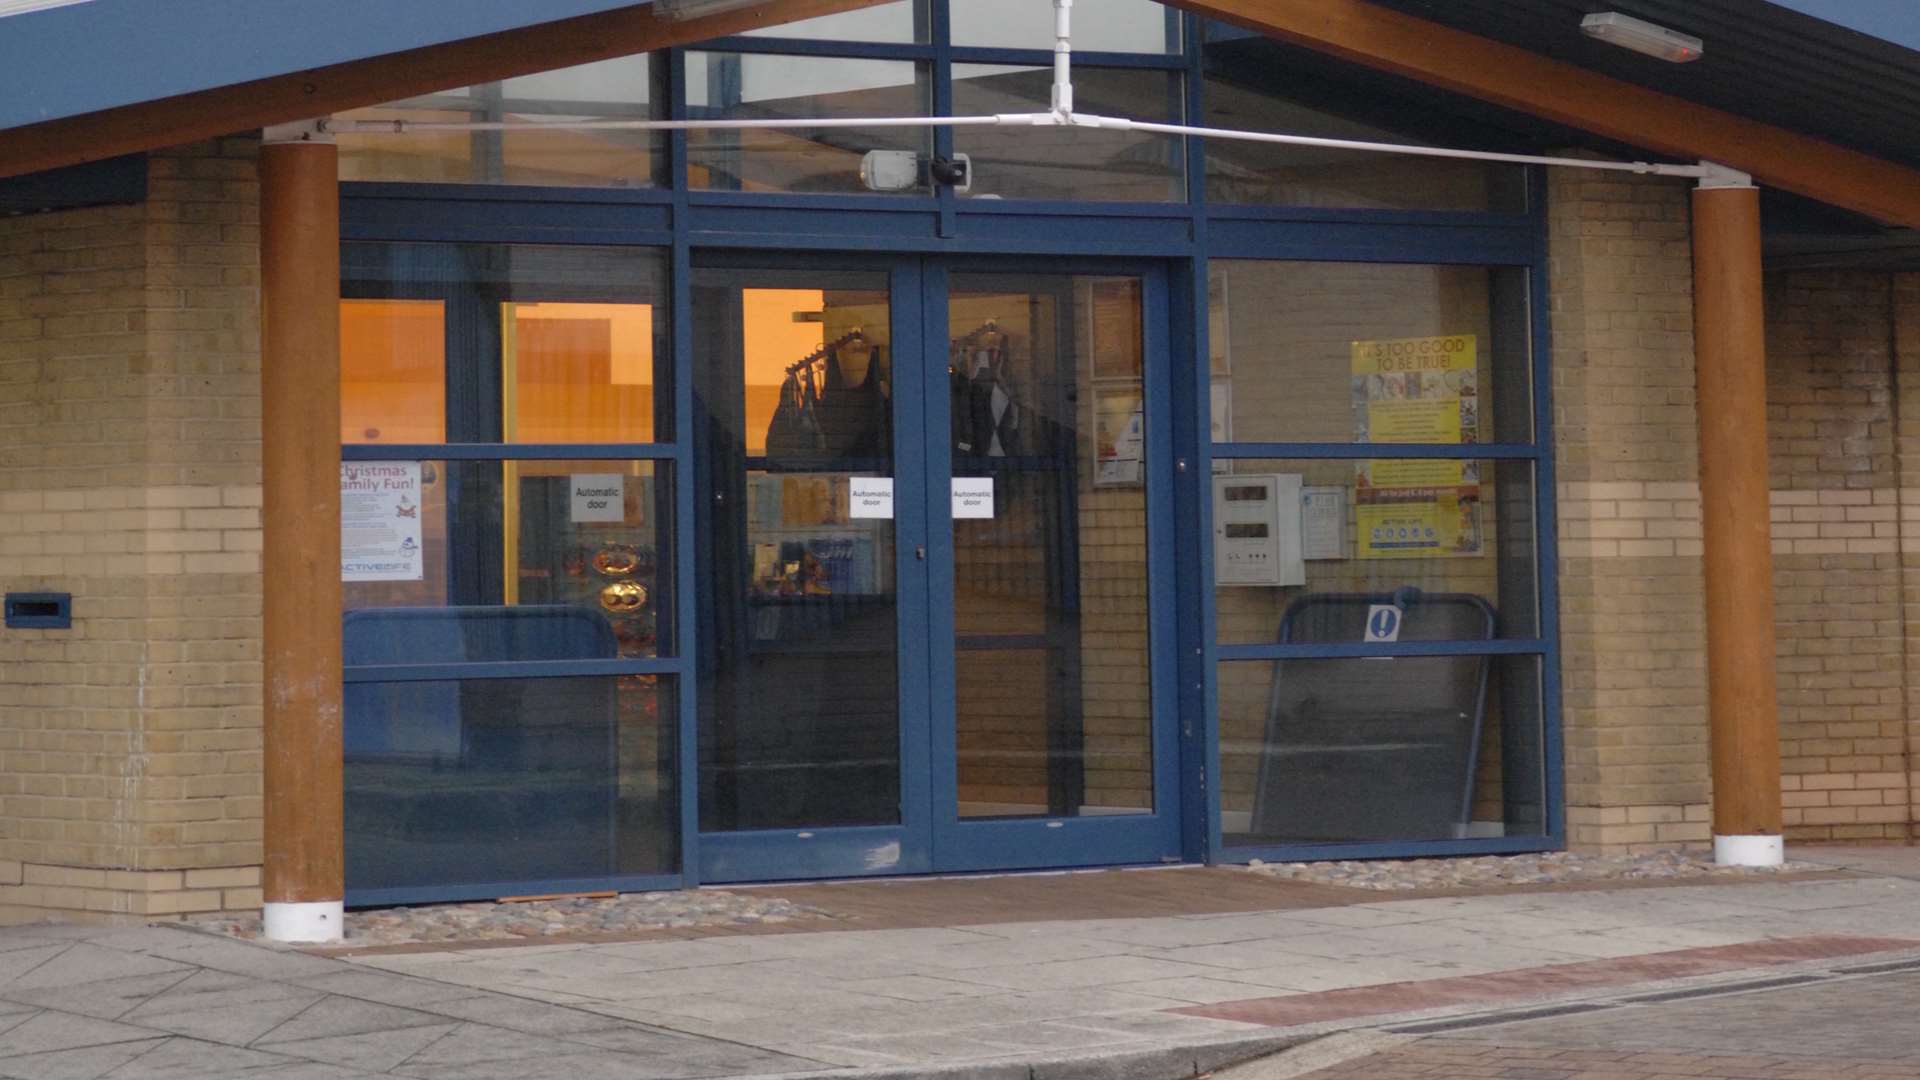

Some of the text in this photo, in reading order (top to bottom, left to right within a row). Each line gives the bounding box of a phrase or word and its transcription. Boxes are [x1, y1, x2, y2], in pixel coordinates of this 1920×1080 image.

[1386, 342, 1415, 357] TOO
[1419, 339, 1465, 354] GOOD
[1375, 354, 1451, 371] TO BE TRUE!
[341, 477, 414, 492] amily Fun!
[576, 487, 619, 496] Automatic
[852, 490, 891, 498] Automatic
[953, 490, 991, 498] Automatic
[587, 499, 607, 509] door
[862, 498, 881, 506] door
[963, 498, 982, 506] door
